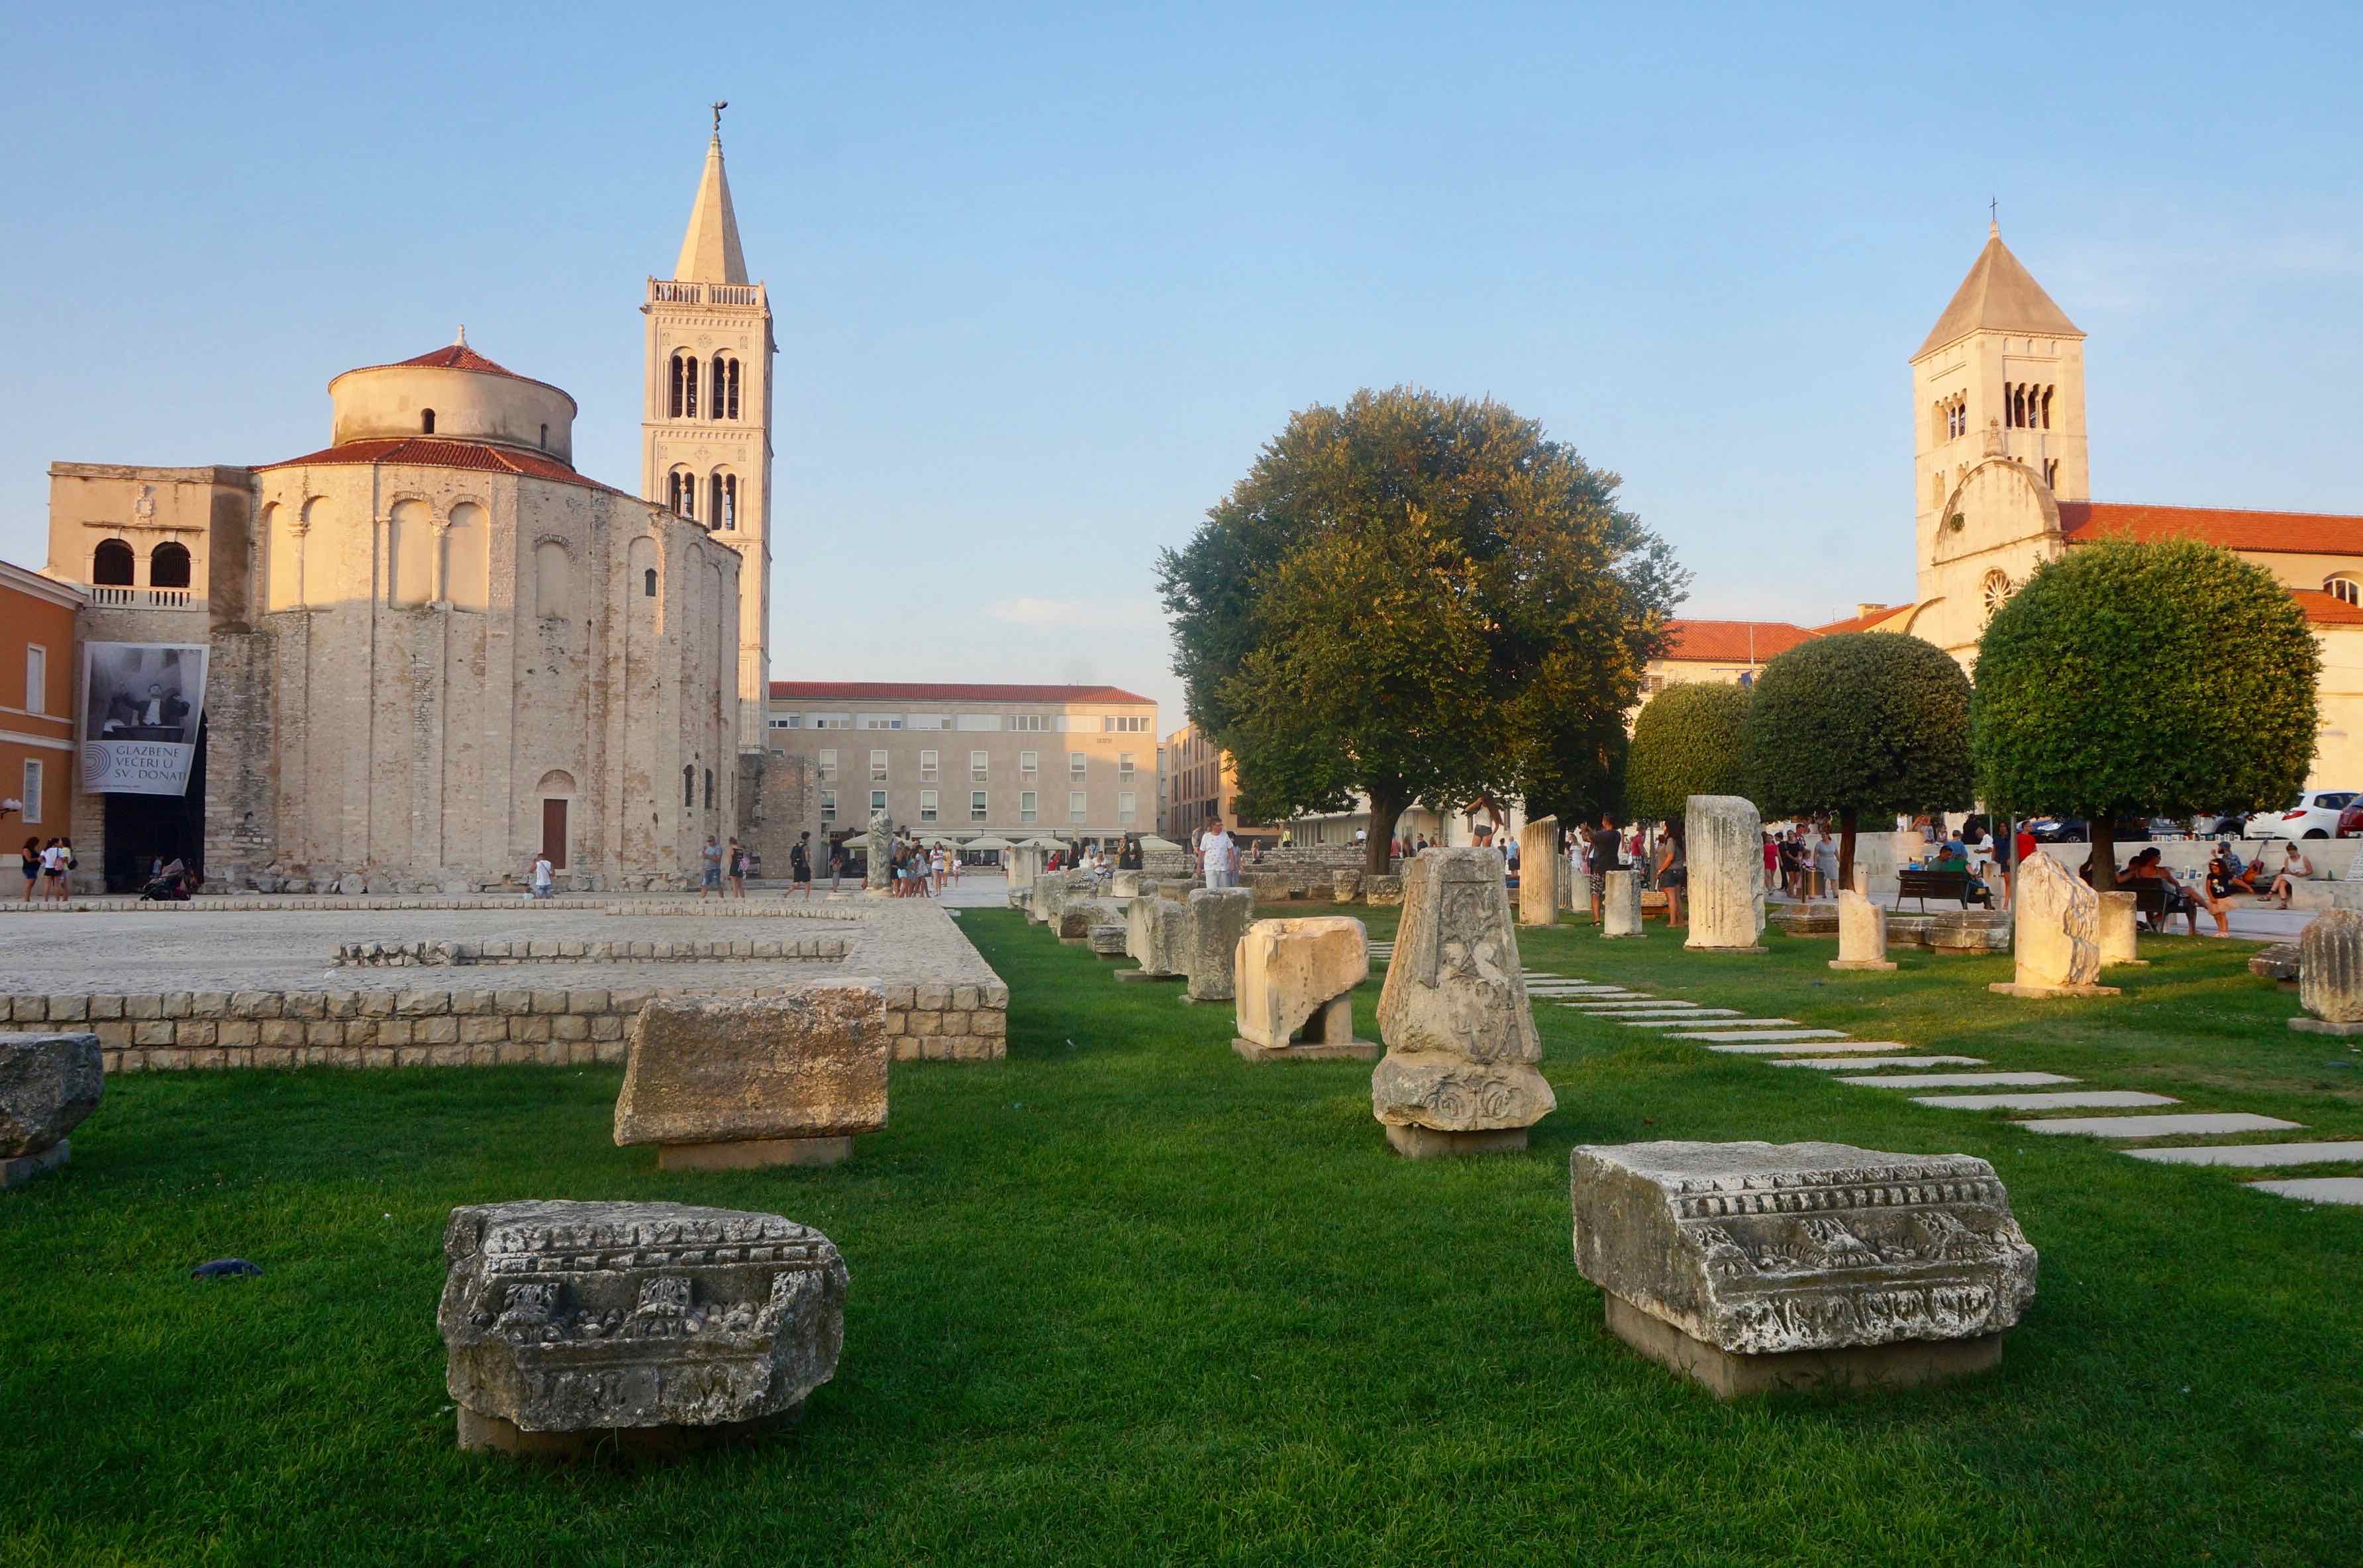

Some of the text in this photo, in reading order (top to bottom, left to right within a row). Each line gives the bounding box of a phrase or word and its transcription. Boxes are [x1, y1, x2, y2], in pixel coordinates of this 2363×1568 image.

[117, 746, 180, 758] GLAZBENE
[116, 756, 174, 769] VEČERI U
[115, 769, 133, 779] SV.
